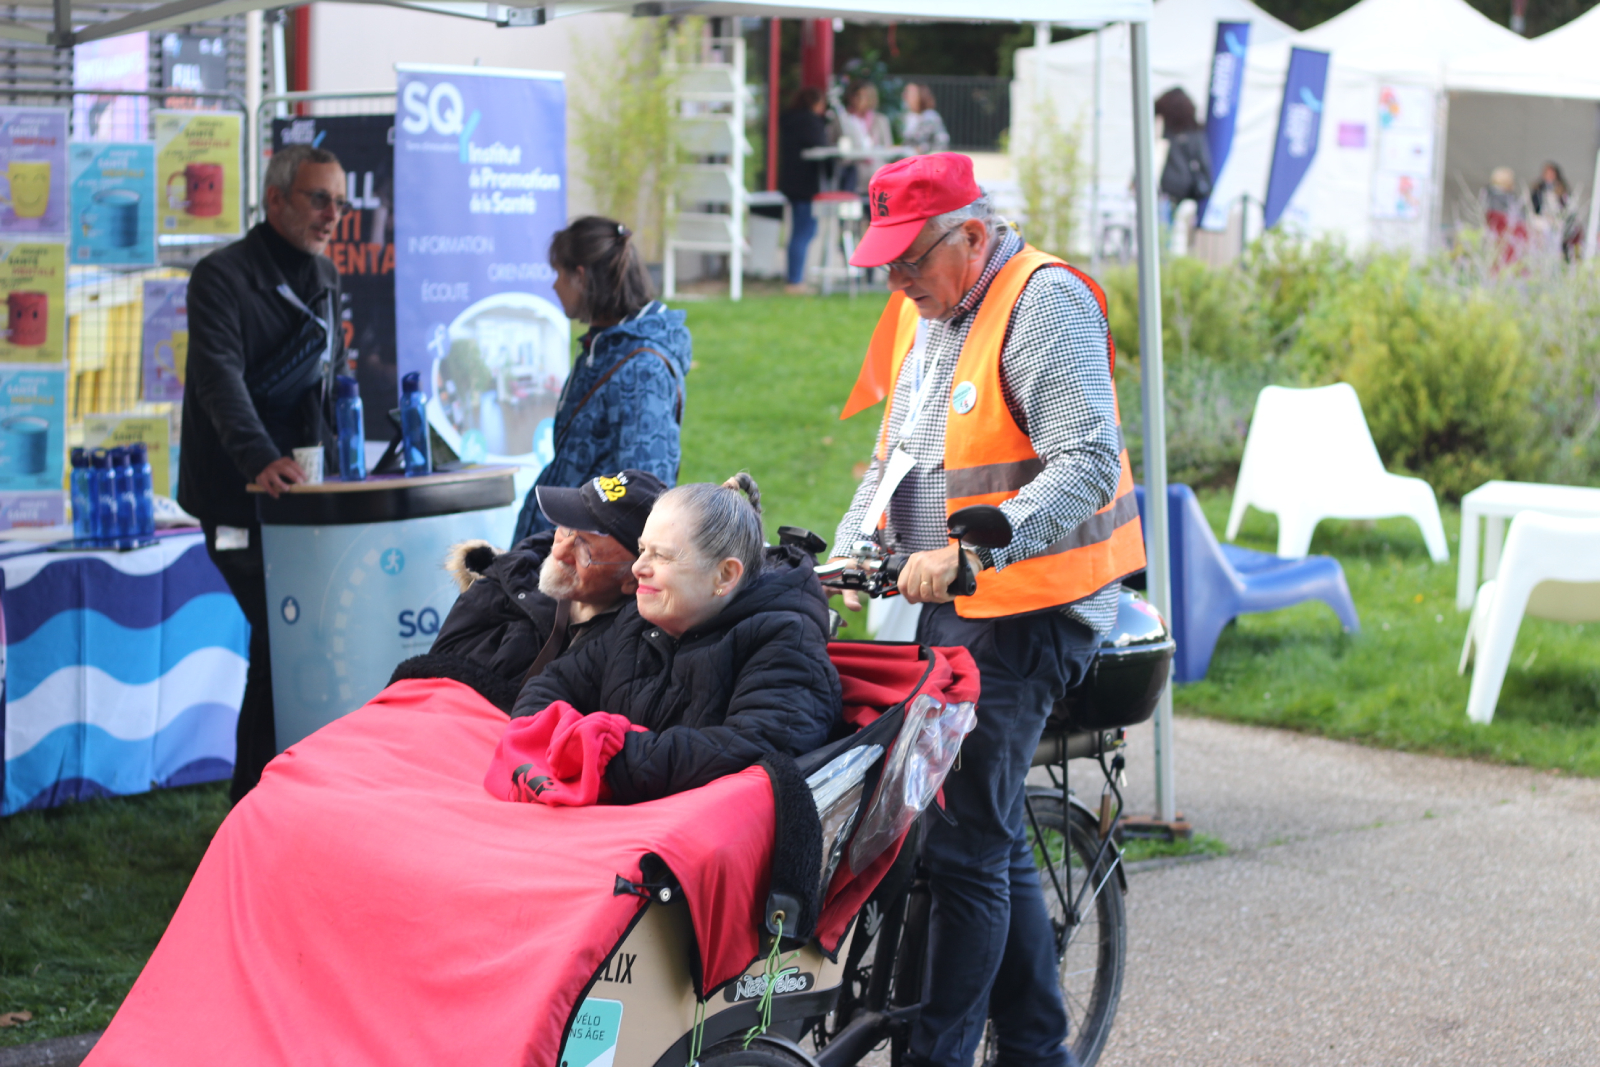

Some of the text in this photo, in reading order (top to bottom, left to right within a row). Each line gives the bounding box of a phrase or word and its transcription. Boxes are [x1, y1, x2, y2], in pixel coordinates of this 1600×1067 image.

[407, 235, 496, 255] INFORMATION
[487, 262, 558, 283] ORIENTATIO
[575, 1012, 601, 1026] VÉLO
